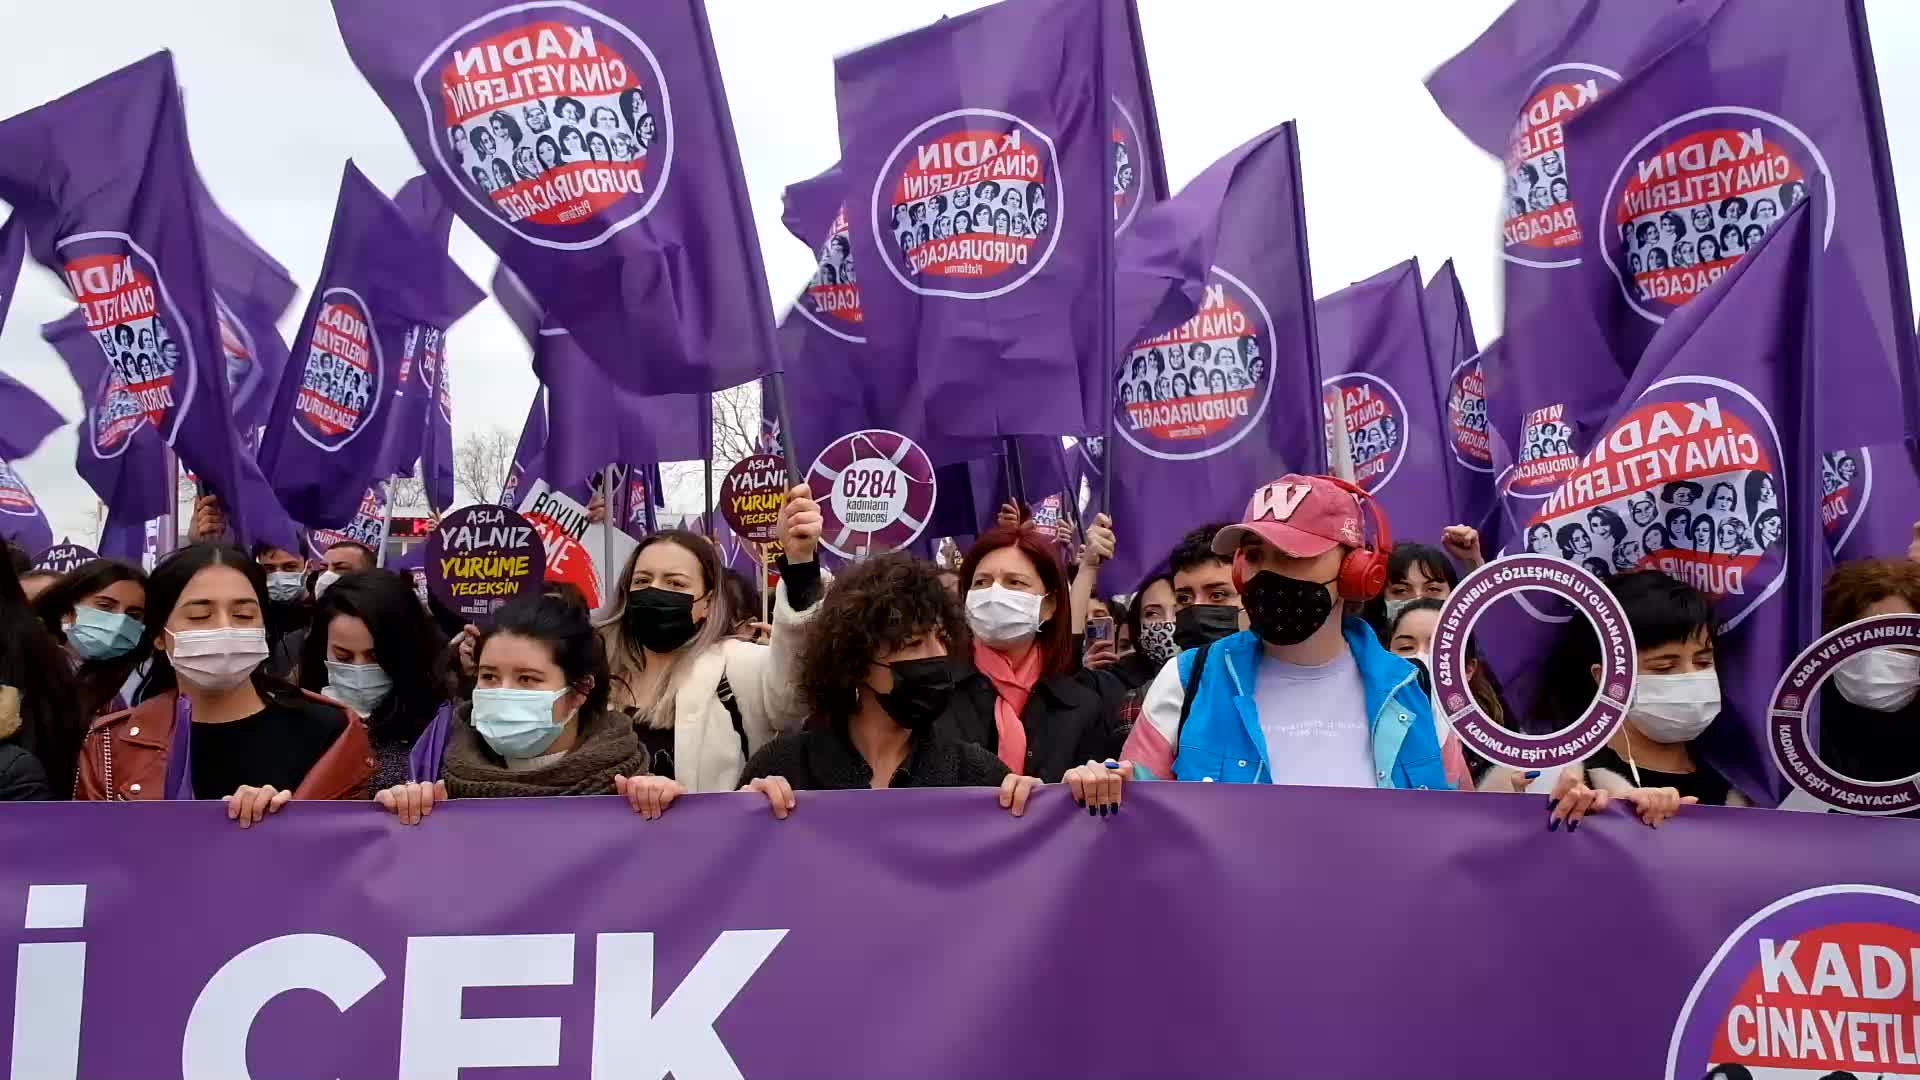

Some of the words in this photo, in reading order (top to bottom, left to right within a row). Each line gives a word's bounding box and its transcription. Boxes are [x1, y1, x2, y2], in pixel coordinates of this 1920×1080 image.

[747, 457, 775, 471] ASLA
[730, 469, 788, 493] YALNI
[842, 469, 896, 499] 6284
[530, 491, 592, 542] BOYUN
[846, 510, 888, 523] güvencesi
[1253, 483, 1312, 522] W
[466, 509, 505, 525] ASLA
[440, 525, 533, 551] YALNIZ
[48, 547, 77, 560] ASLA
[440, 551, 530, 579] YÜRÜME
[451, 578, 519, 597] YECEKSİN
[1494, 566, 1576, 587] SÖZLEŞMESİ
[1446, 577, 1495, 632] İSTANBUL
[1441, 631, 1455, 651] VE
[1573, 580, 1627, 676] UYGULANACAK
[1439, 653, 1453, 687] 6284
[1793, 659, 1822, 688] 6284
[1818, 645, 1840, 661] VE
[1840, 625, 1914, 650] İSTANBUL
[1465, 721, 1521, 759] KADINLAR
[1521, 748, 1548, 763] EŞİT
[1548, 712, 1613, 758] YAŞAYACAK
[1779, 724, 1810, 776] KADINLAR
[1803, 771, 1829, 789] EŞİT
[1830, 788, 1912, 806] YAŞAYACAK
